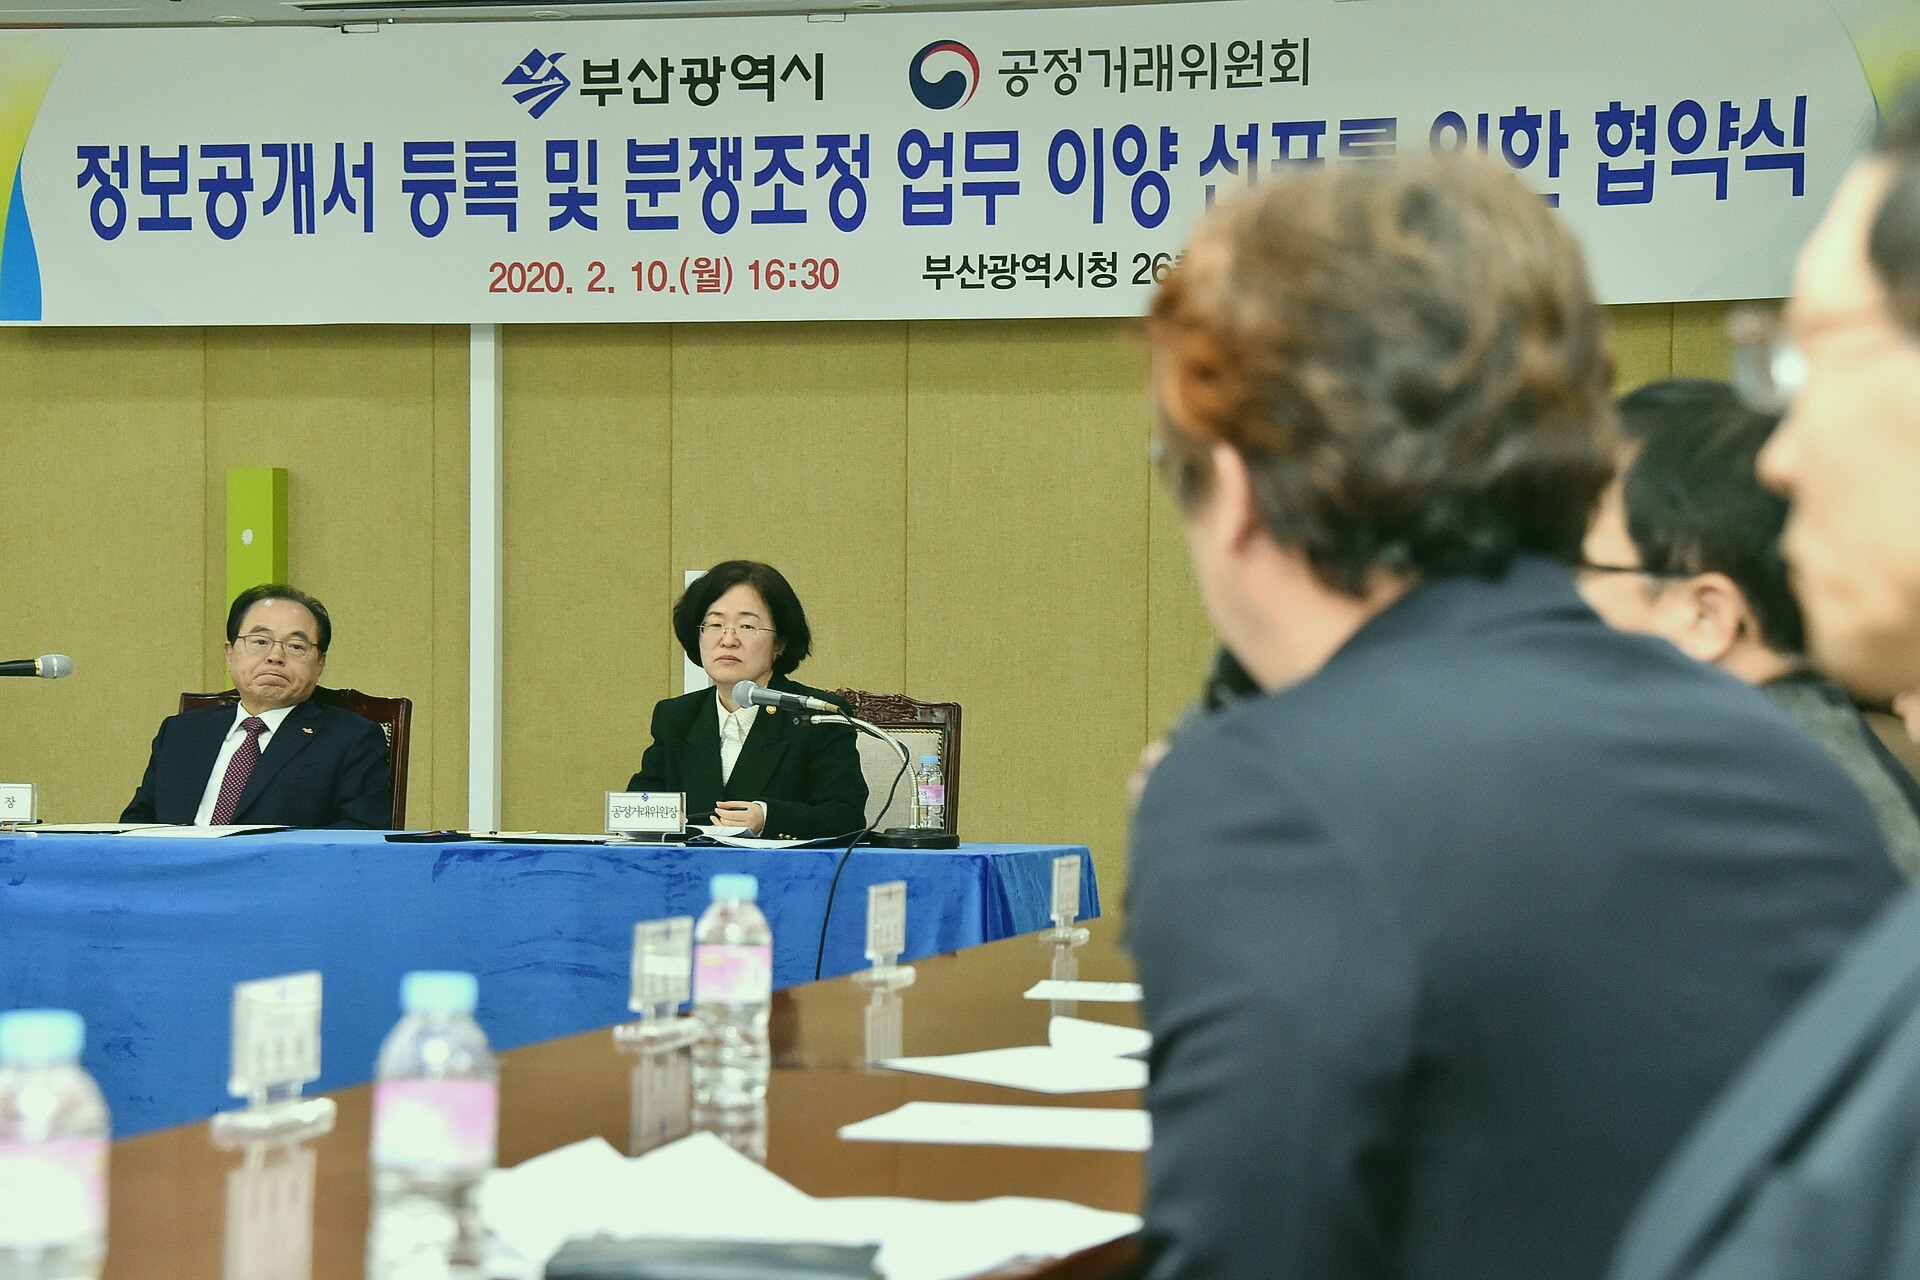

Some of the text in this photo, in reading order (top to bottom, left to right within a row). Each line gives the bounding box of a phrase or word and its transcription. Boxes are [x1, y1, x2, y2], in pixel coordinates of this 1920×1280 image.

[580, 53, 824, 106] 부산광역시
[998, 38, 1310, 97] 공정거래위원회
[77, 142, 374, 240] 정보공개서
[402, 140, 518, 238] 등록
[546, 139, 598, 231] 및
[625, 134, 870, 234] 분쟁조정
[898, 129, 1020, 225] 업무
[1048, 124, 1178, 229] 이양
[1595, 96, 1807, 206] 협약식
[488, 256, 840, 295] 2020. 2. 10.(월) 16:30
[922, 250, 1189, 290] 부산광역시청 26
[611, 805, 679, 819] 공정거래위원장
